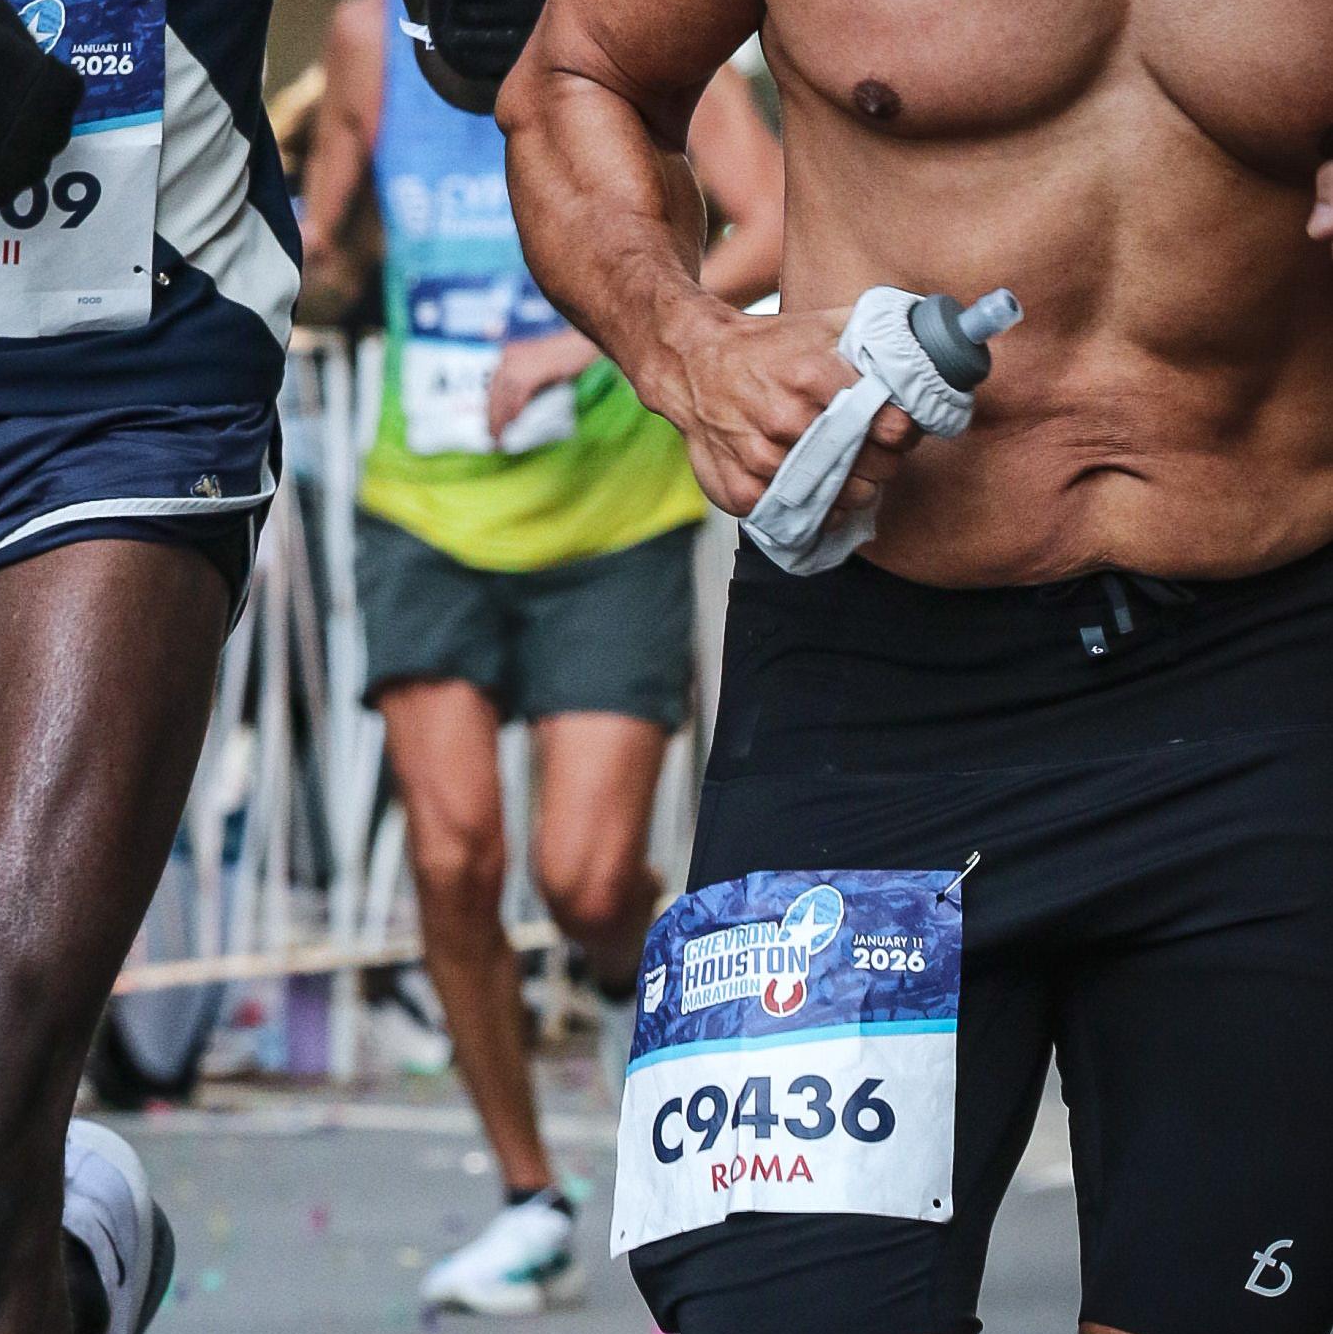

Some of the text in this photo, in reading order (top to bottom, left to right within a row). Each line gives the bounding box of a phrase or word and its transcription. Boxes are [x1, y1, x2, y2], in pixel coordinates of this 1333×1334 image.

[71, 43, 119, 54] JANUARY
[70, 54, 134, 76] 2026
[77, 296, 102, 305] FOOD
[686, 923, 776, 961] CHEVRON
[853, 933, 924, 950] JANUARY 11
[685, 945, 807, 992] HOUSTON
[853, 947, 926, 973] 2026
[682, 978, 761, 1013] MARATHON
[652, 1074, 896, 1164] C9436
[711, 1154, 814, 1193] ROMA
